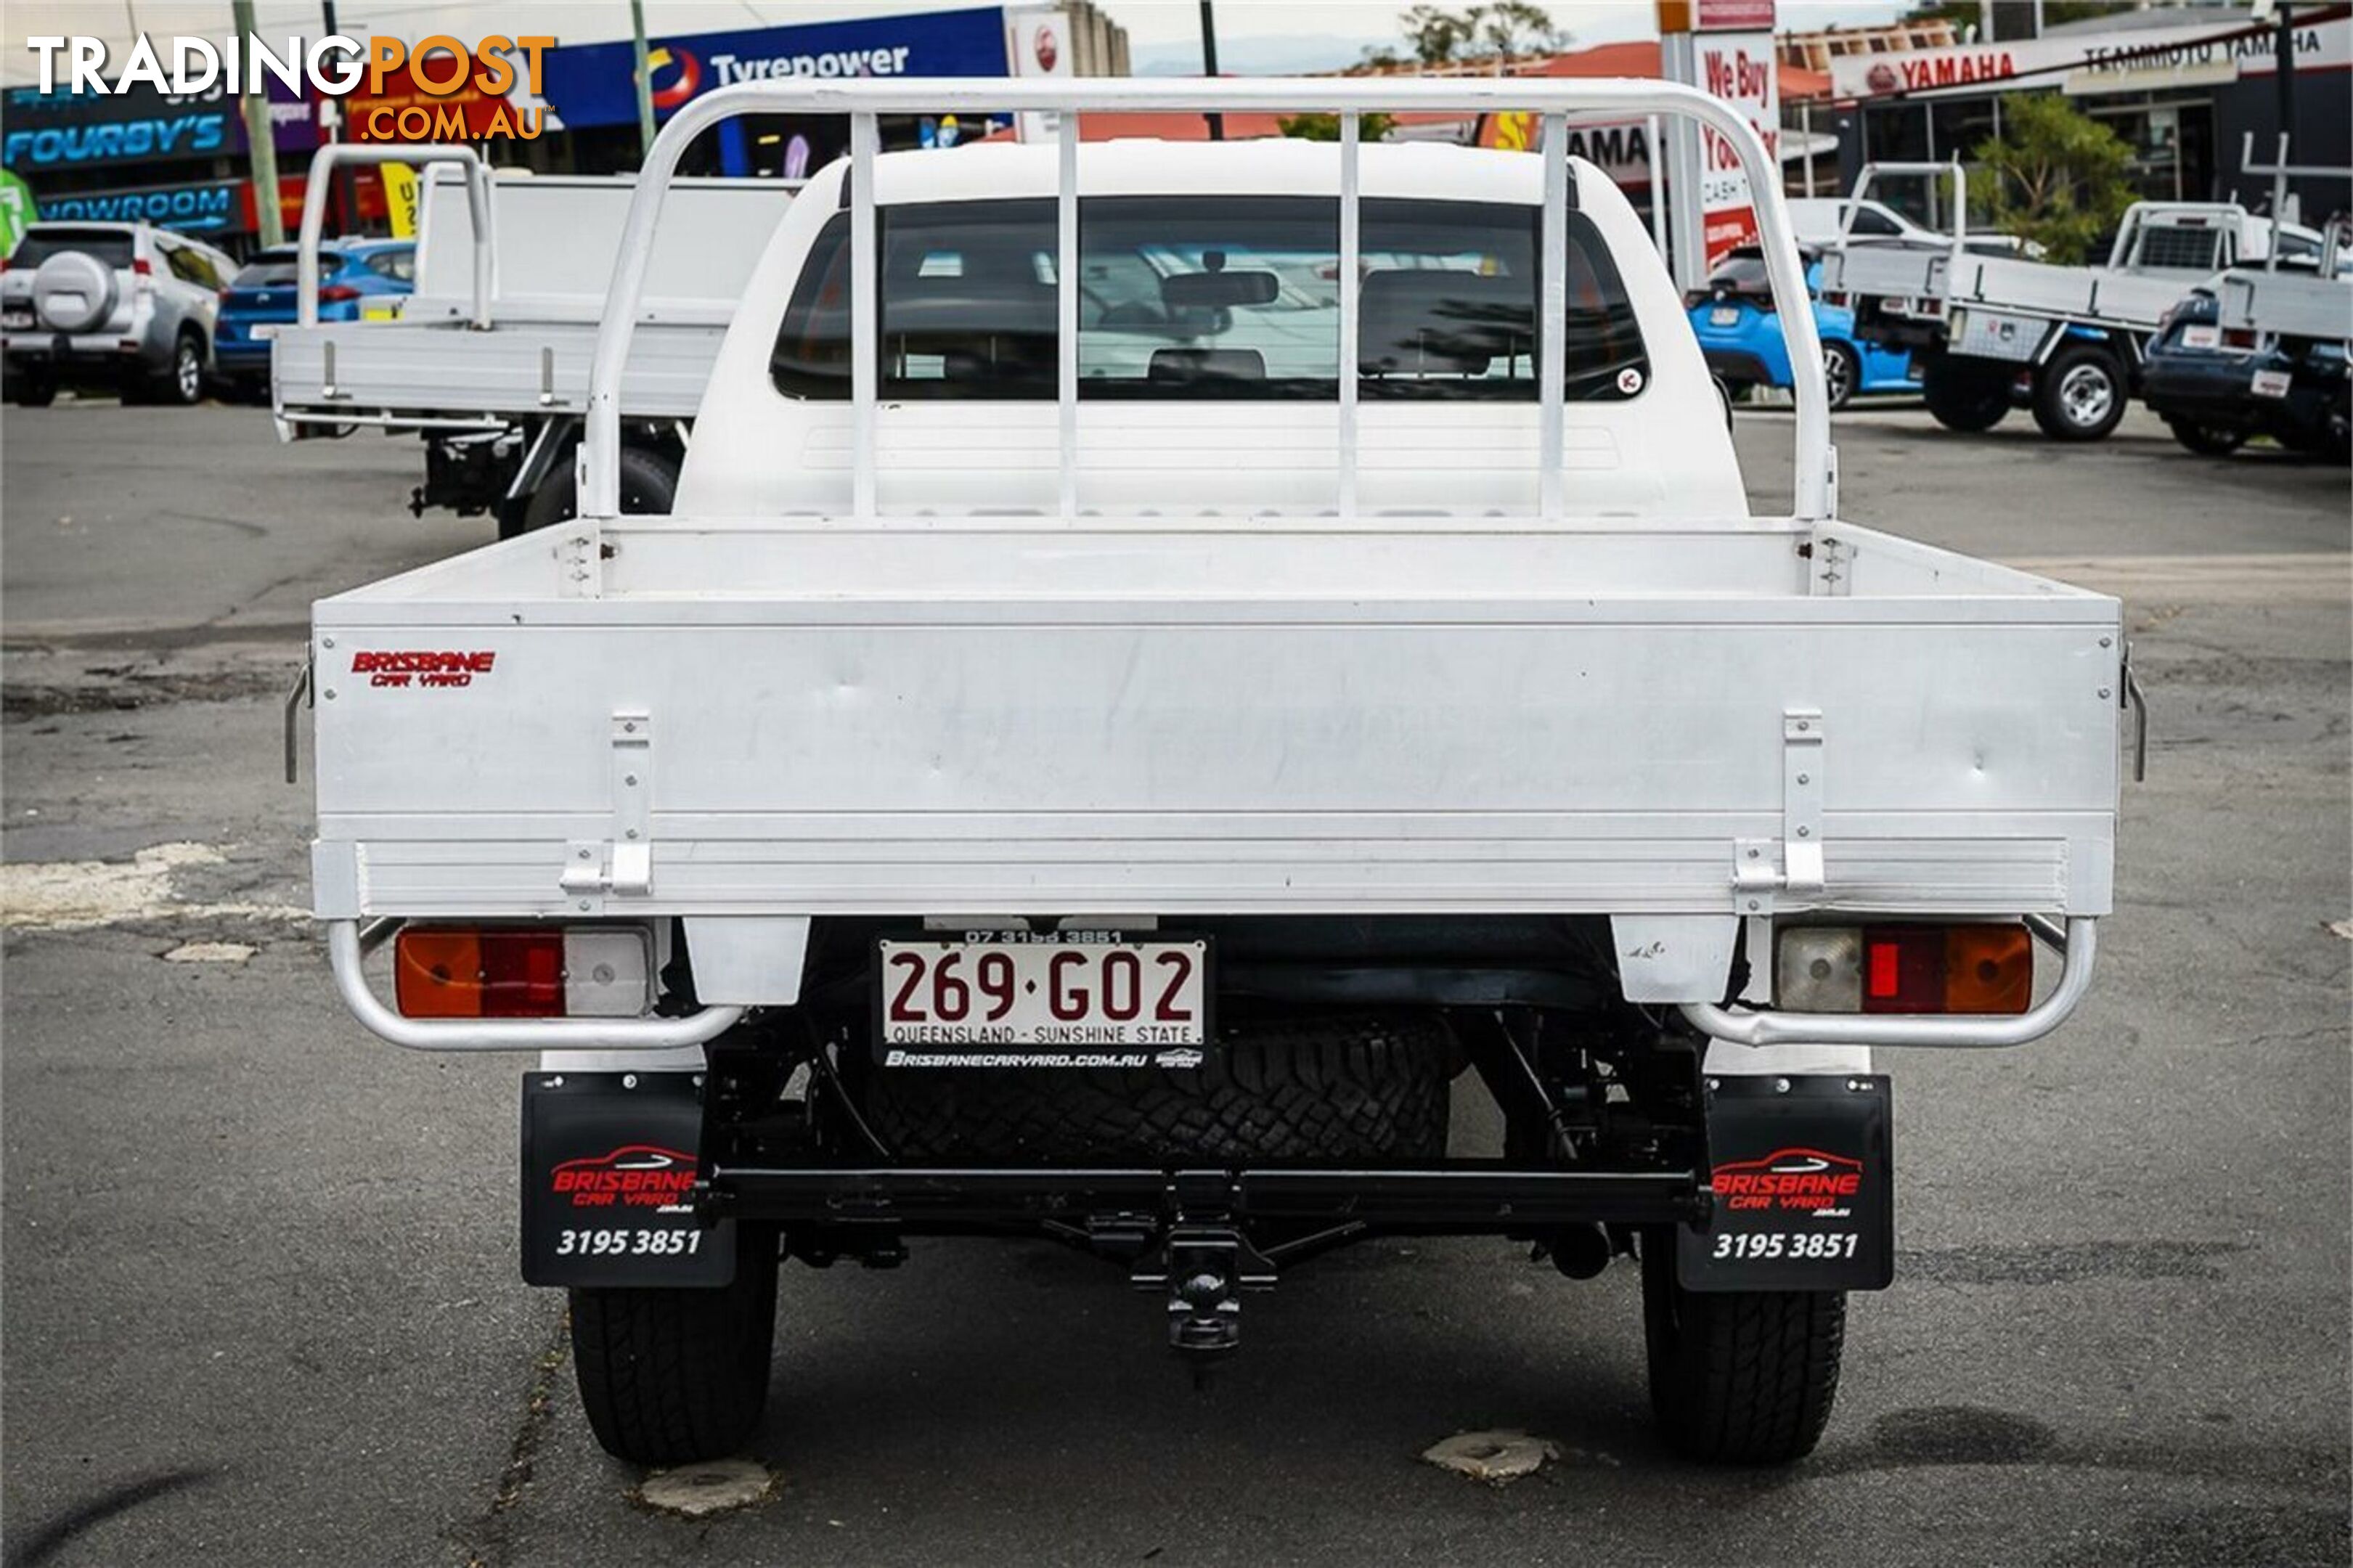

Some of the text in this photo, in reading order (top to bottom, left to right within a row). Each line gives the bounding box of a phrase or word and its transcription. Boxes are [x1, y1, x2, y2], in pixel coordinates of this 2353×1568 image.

[2224, 30, 2320, 62] YAMHA
[710, 46, 909, 86] Tyrepower
[1704, 49, 1769, 108] We Buy
[1901, 52, 2015, 89] YAMAHA
[4, 115, 225, 166] FOURBY'S
[39, 188, 229, 220] HOWROOM
[352, 652, 495, 673] BRISBANE
[371, 674, 473, 687] CAR YARD
[965, 931, 994, 944] 07
[1066, 931, 1122, 944] 3851
[889, 951, 1015, 1022] 269
[893, 1025, 1015, 1044] QUEENSLAND
[1035, 1025, 1126, 1043] SUNSHINE
[1136, 1024, 1191, 1042] STATE
[552, 1171, 698, 1192] BRISBANE
[1711, 1174, 1861, 1195] BRISBANE
[572, 1192, 679, 1206] CAR YARD
[1729, 1196, 1835, 1209] CAR YARD
[555, 1229, 702, 1254] 3195 3851
[1712, 1233, 1859, 1259] 3195 3851
